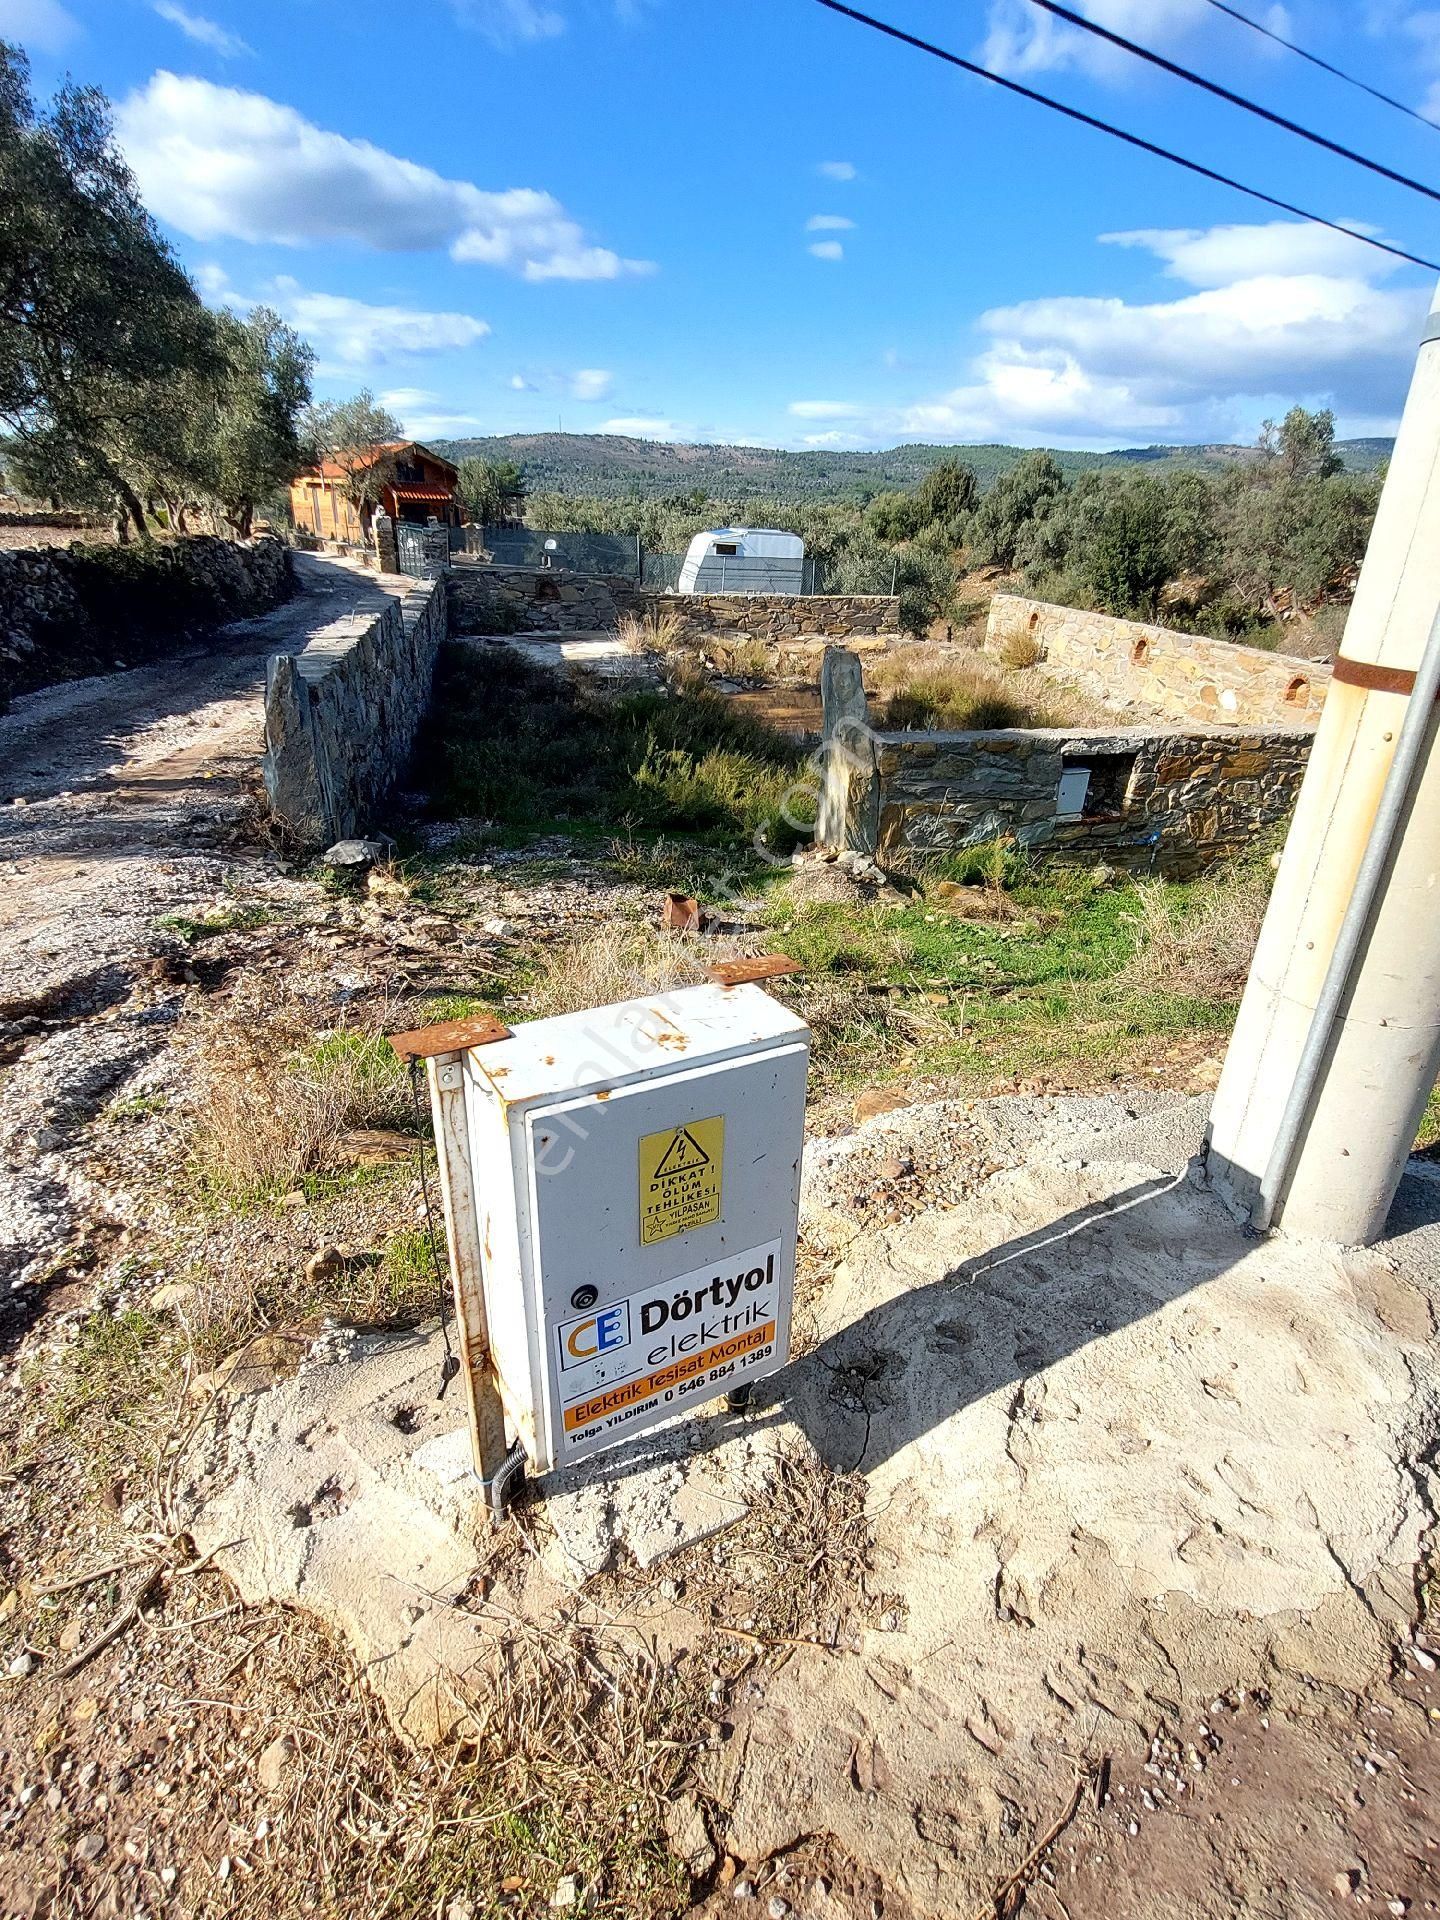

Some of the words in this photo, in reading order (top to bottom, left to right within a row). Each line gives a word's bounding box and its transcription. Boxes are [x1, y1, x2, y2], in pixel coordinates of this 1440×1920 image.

[647, 1183, 716, 1214] TEHLİKESİ
[650, 1167, 706, 1192] DİKKAT
[662, 1180, 702, 1198] ÖLÜM
[669, 1200, 710, 1219] YILPASAN
[640, 1254, 775, 1336] Dörtyol
[647, 1300, 770, 1365] elektrik
[570, 1425, 603, 1444] Tolga
[606, 1398, 659, 1427] YILDIRIM
[664, 1389, 674, 1402] 0
[678, 1376, 705, 1395] 546
[709, 1361, 735, 1382] 884
[740, 1345, 772, 1368] 1389
[575, 1384, 642, 1422] Elektrik
[647, 1354, 705, 1389] Tesisat
[709, 1327, 767, 1363] Montaj
